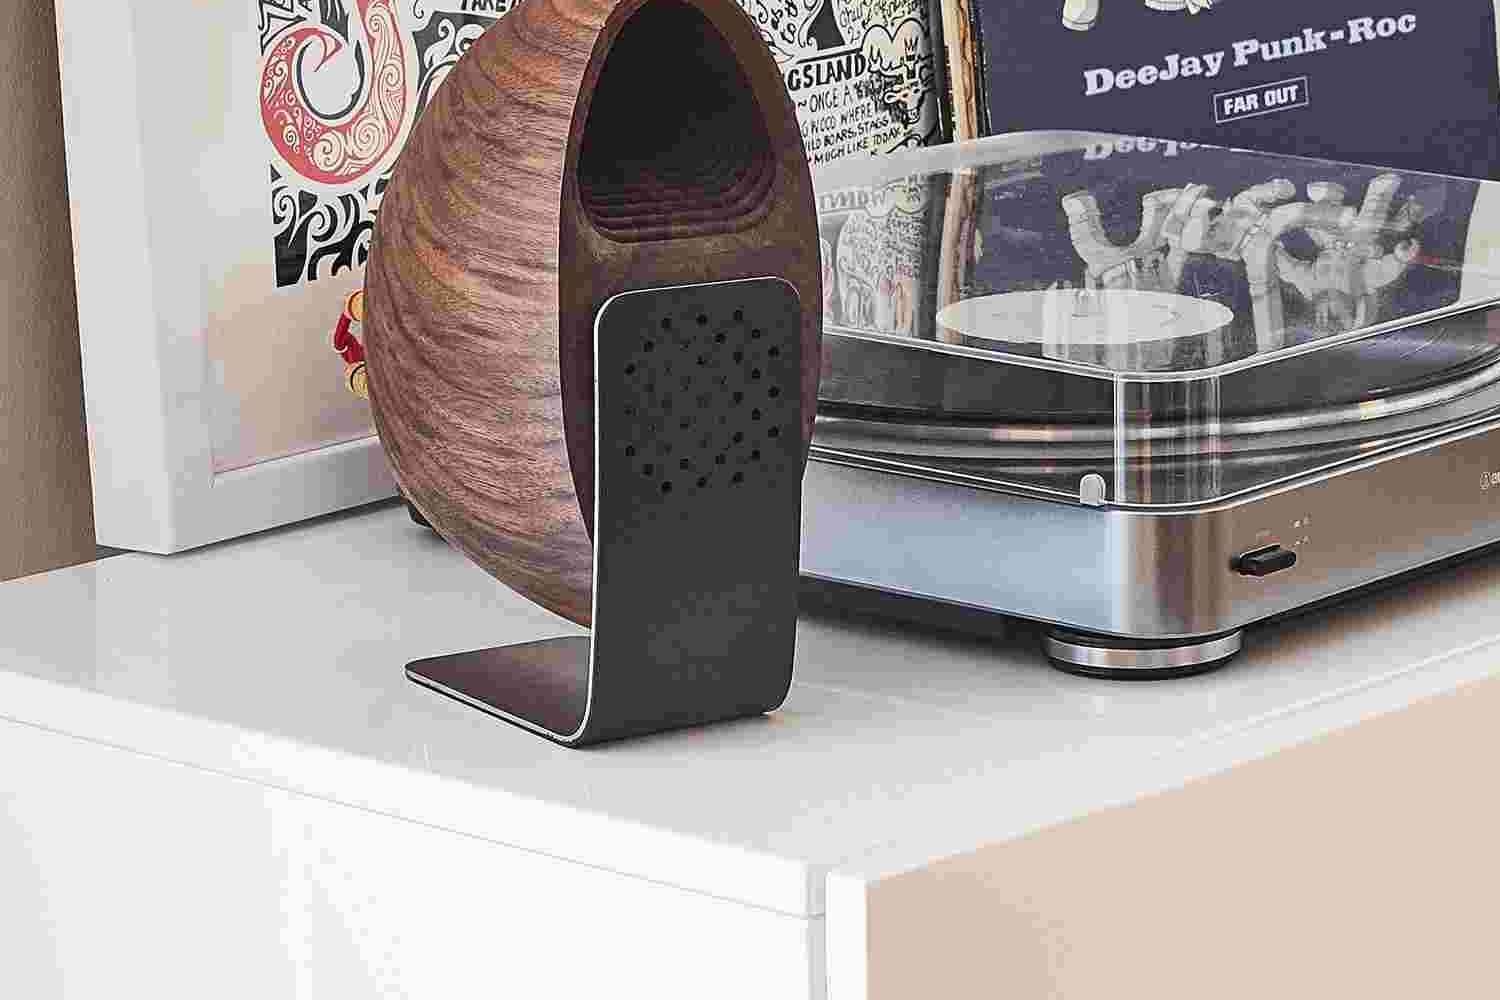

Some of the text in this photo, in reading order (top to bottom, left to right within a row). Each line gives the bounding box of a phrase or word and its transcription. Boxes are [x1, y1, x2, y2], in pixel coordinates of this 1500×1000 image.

[780, 21, 797, 45] to
[1083, 13, 1418, 97] DeeJay Punk-Roc
[1222, 83, 1300, 116] FAR OUT
